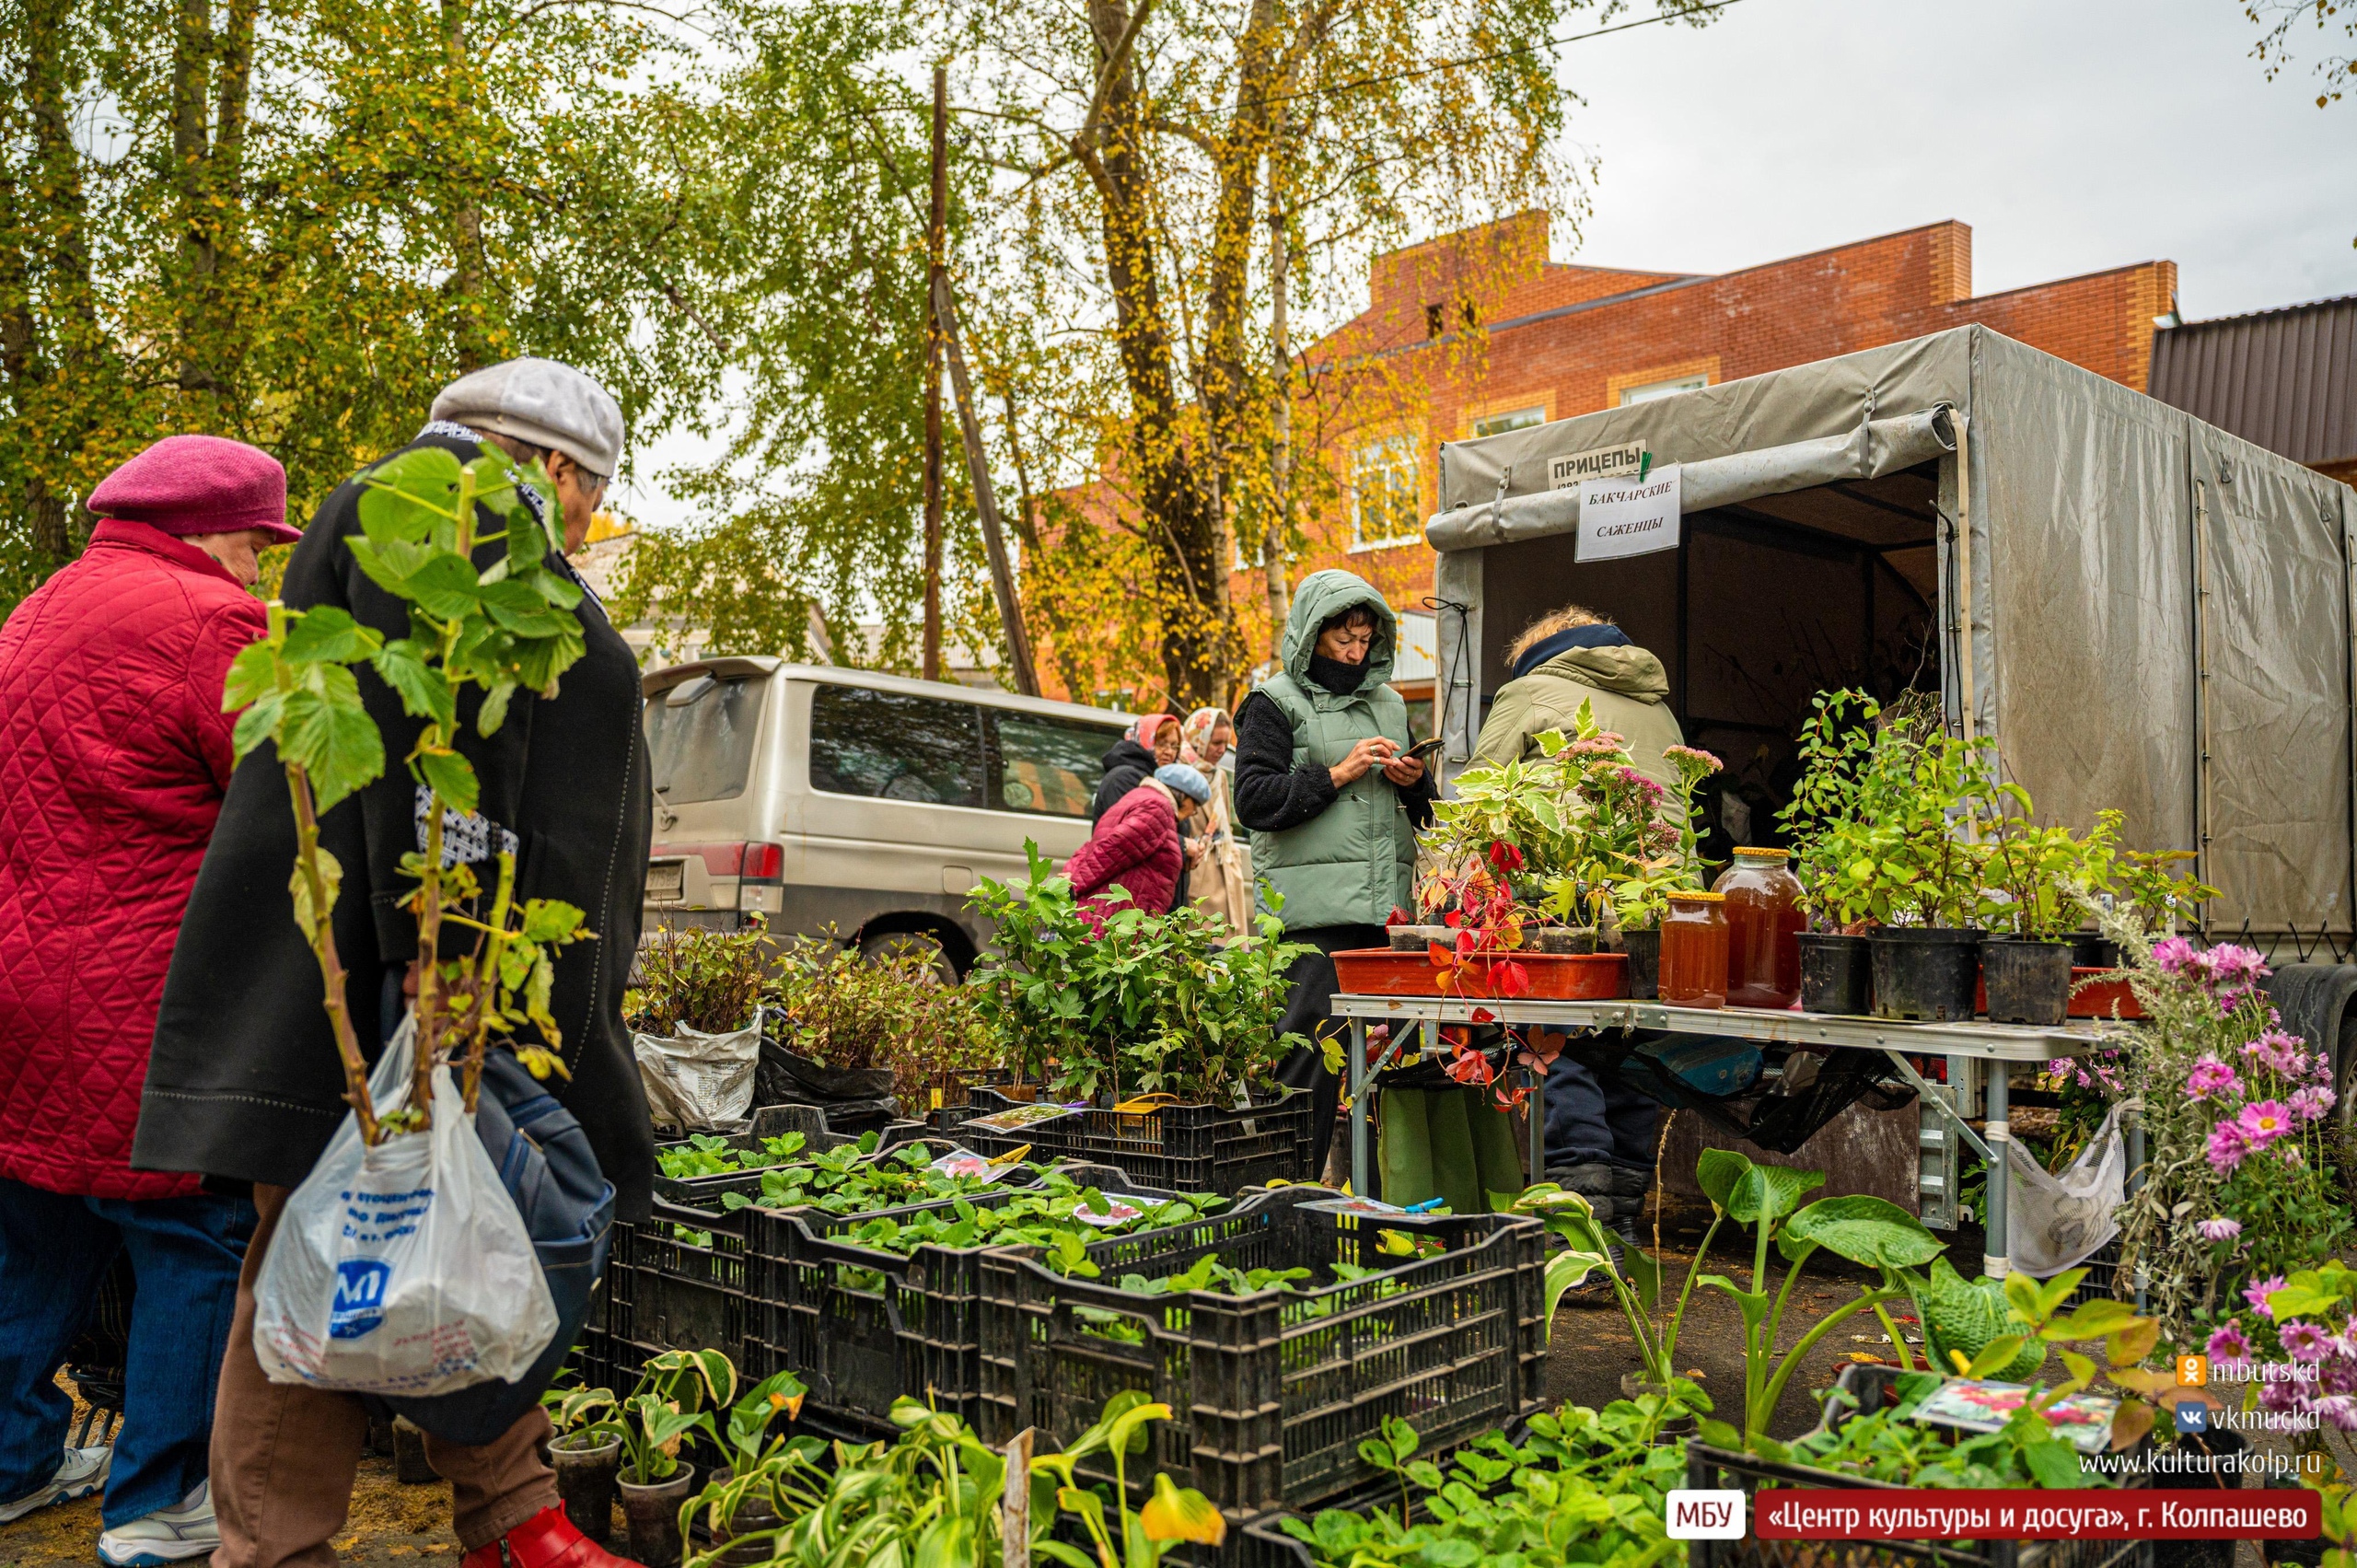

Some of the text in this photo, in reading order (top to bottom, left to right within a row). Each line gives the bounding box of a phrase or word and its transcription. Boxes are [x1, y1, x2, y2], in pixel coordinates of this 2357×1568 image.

[1553, 447, 1640, 479] ПРИЦЕПЫ
[1589, 481, 1673, 505] БАКЧАРСКИЕ
[1596, 517, 1664, 538] САЖЕНЦЫ
